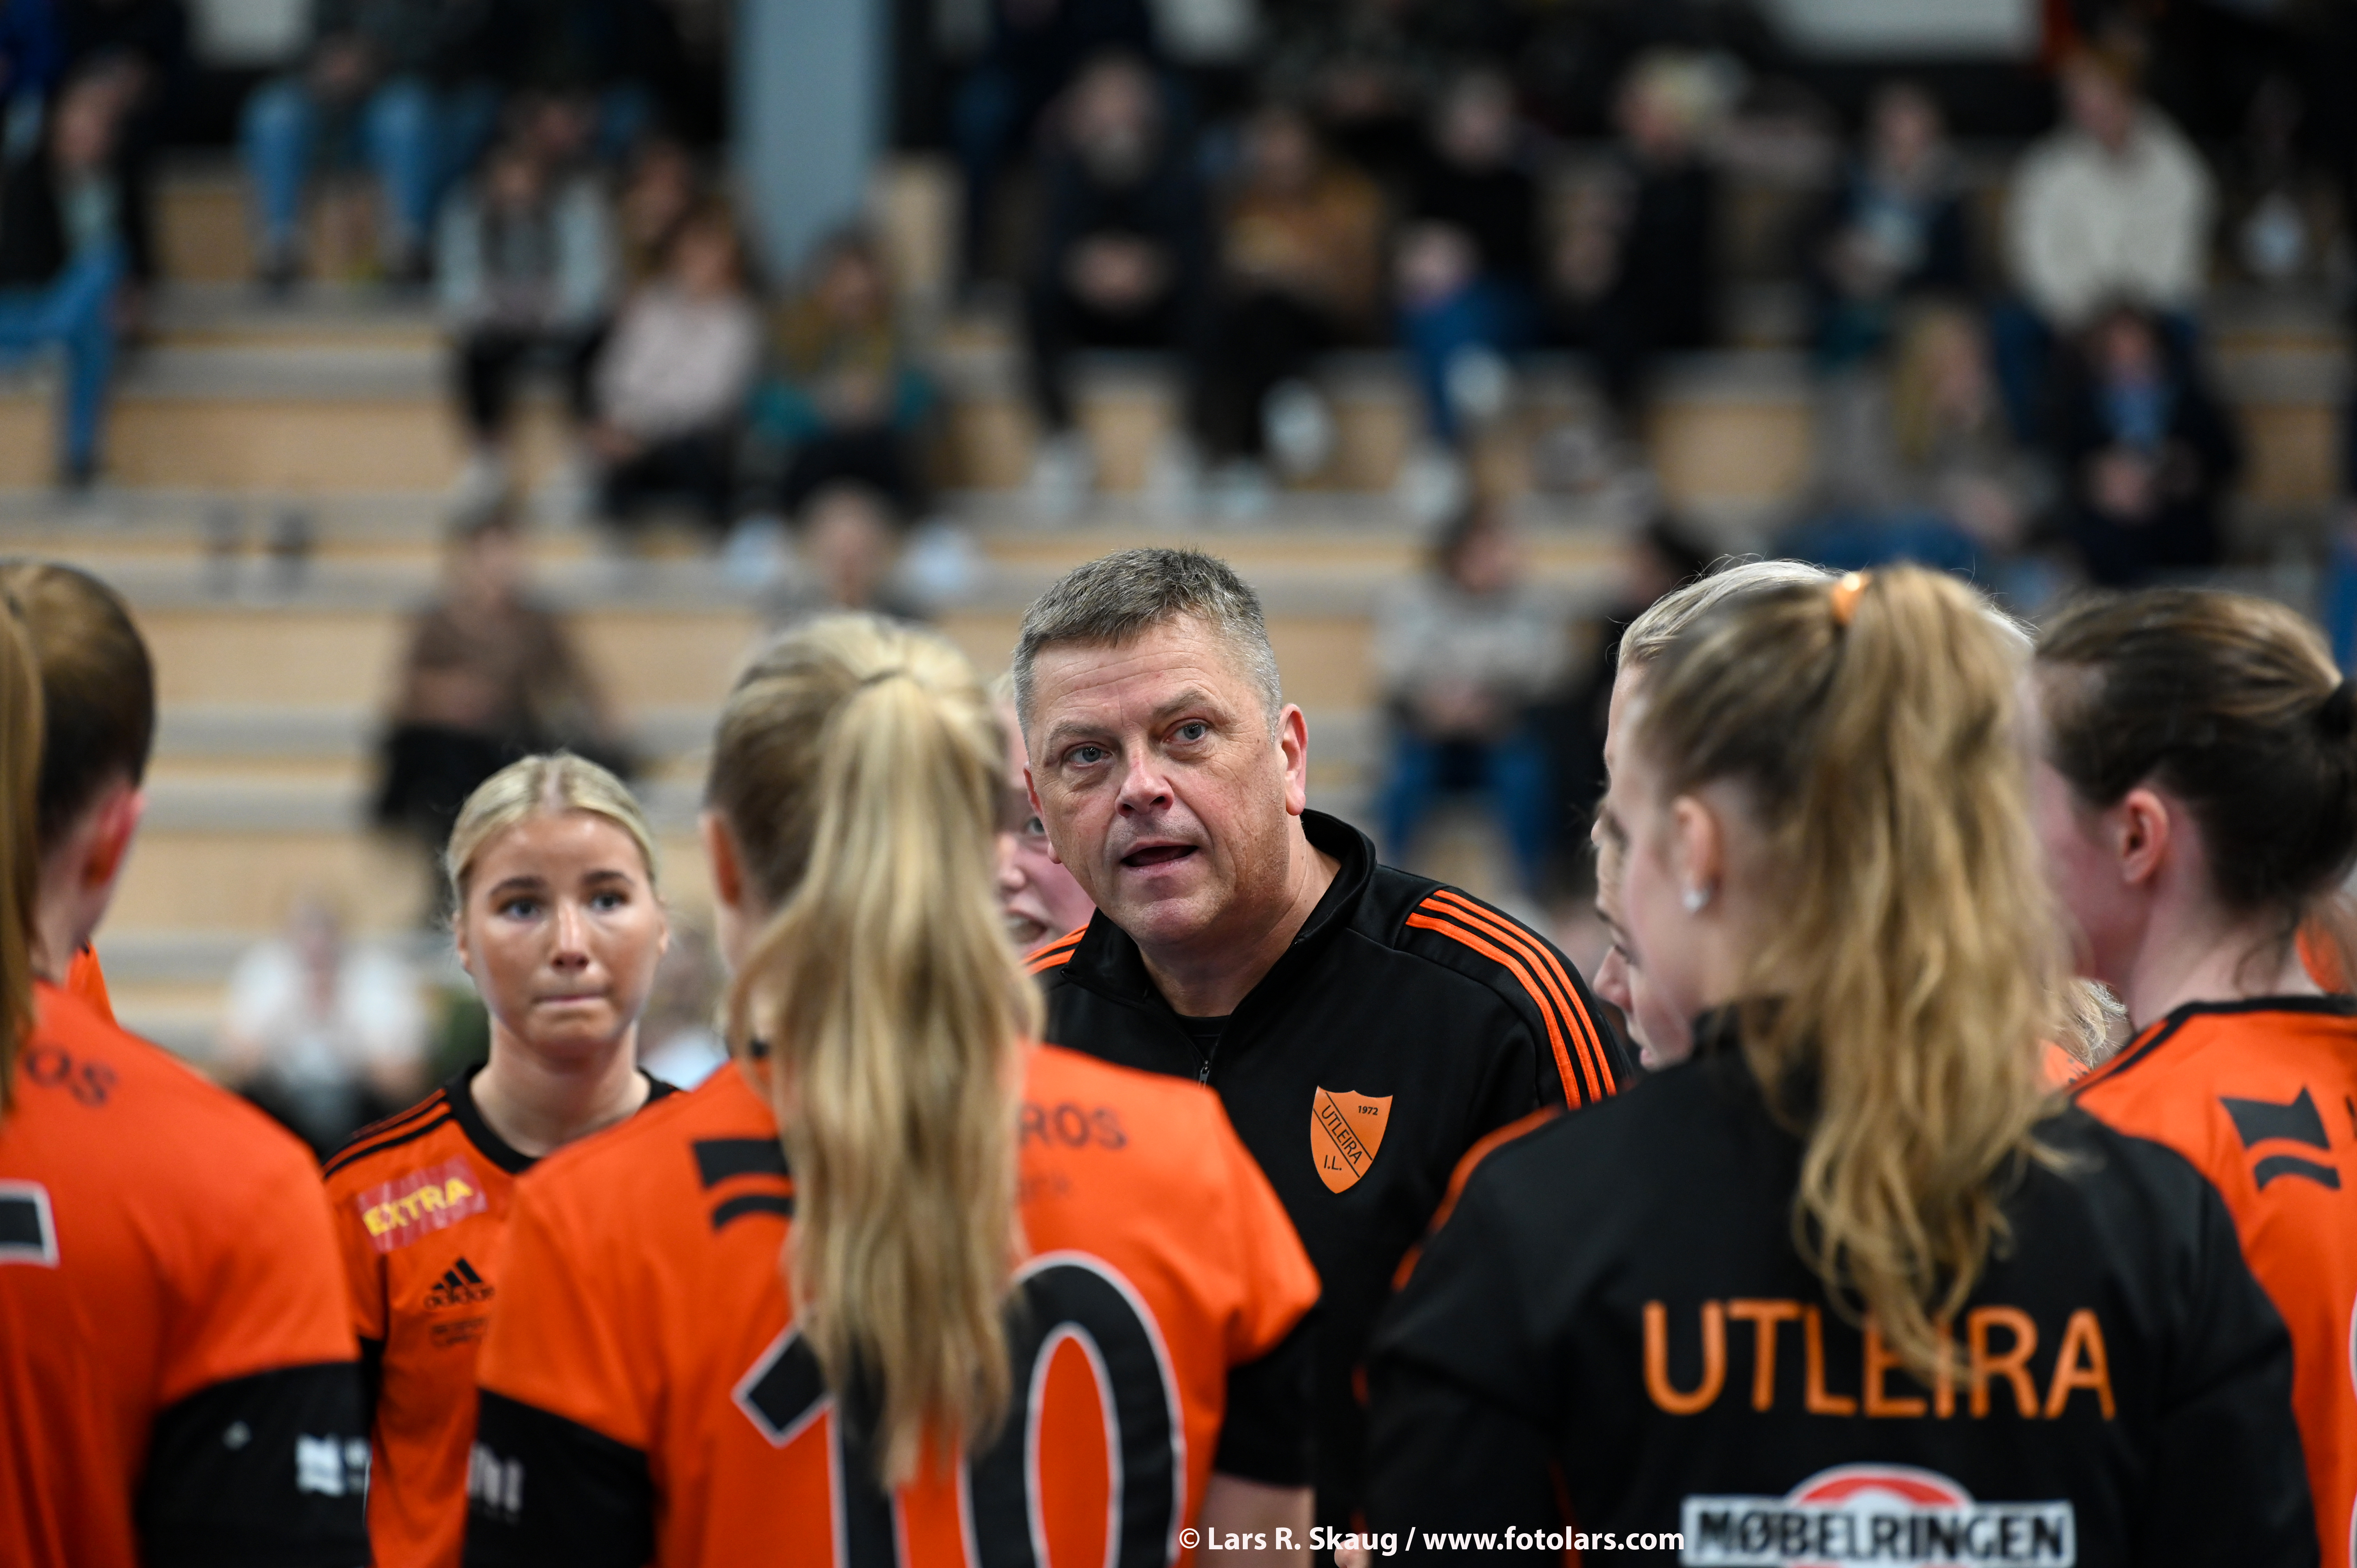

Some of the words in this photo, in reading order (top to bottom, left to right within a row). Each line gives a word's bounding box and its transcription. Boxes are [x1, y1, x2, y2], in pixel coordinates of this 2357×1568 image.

[1321, 1105, 1362, 1164] UTLEIRA
[1358, 1105, 1378, 1116] 1972
[1324, 1155, 1342, 1171] I.L.
[362, 1176, 473, 1237] EXTRA
[1642, 1298, 2116, 1420] UTLEIRA
[731, 1249, 1187, 1568] 10
[1694, 1508, 2065, 1558] MØBELRINGEN
